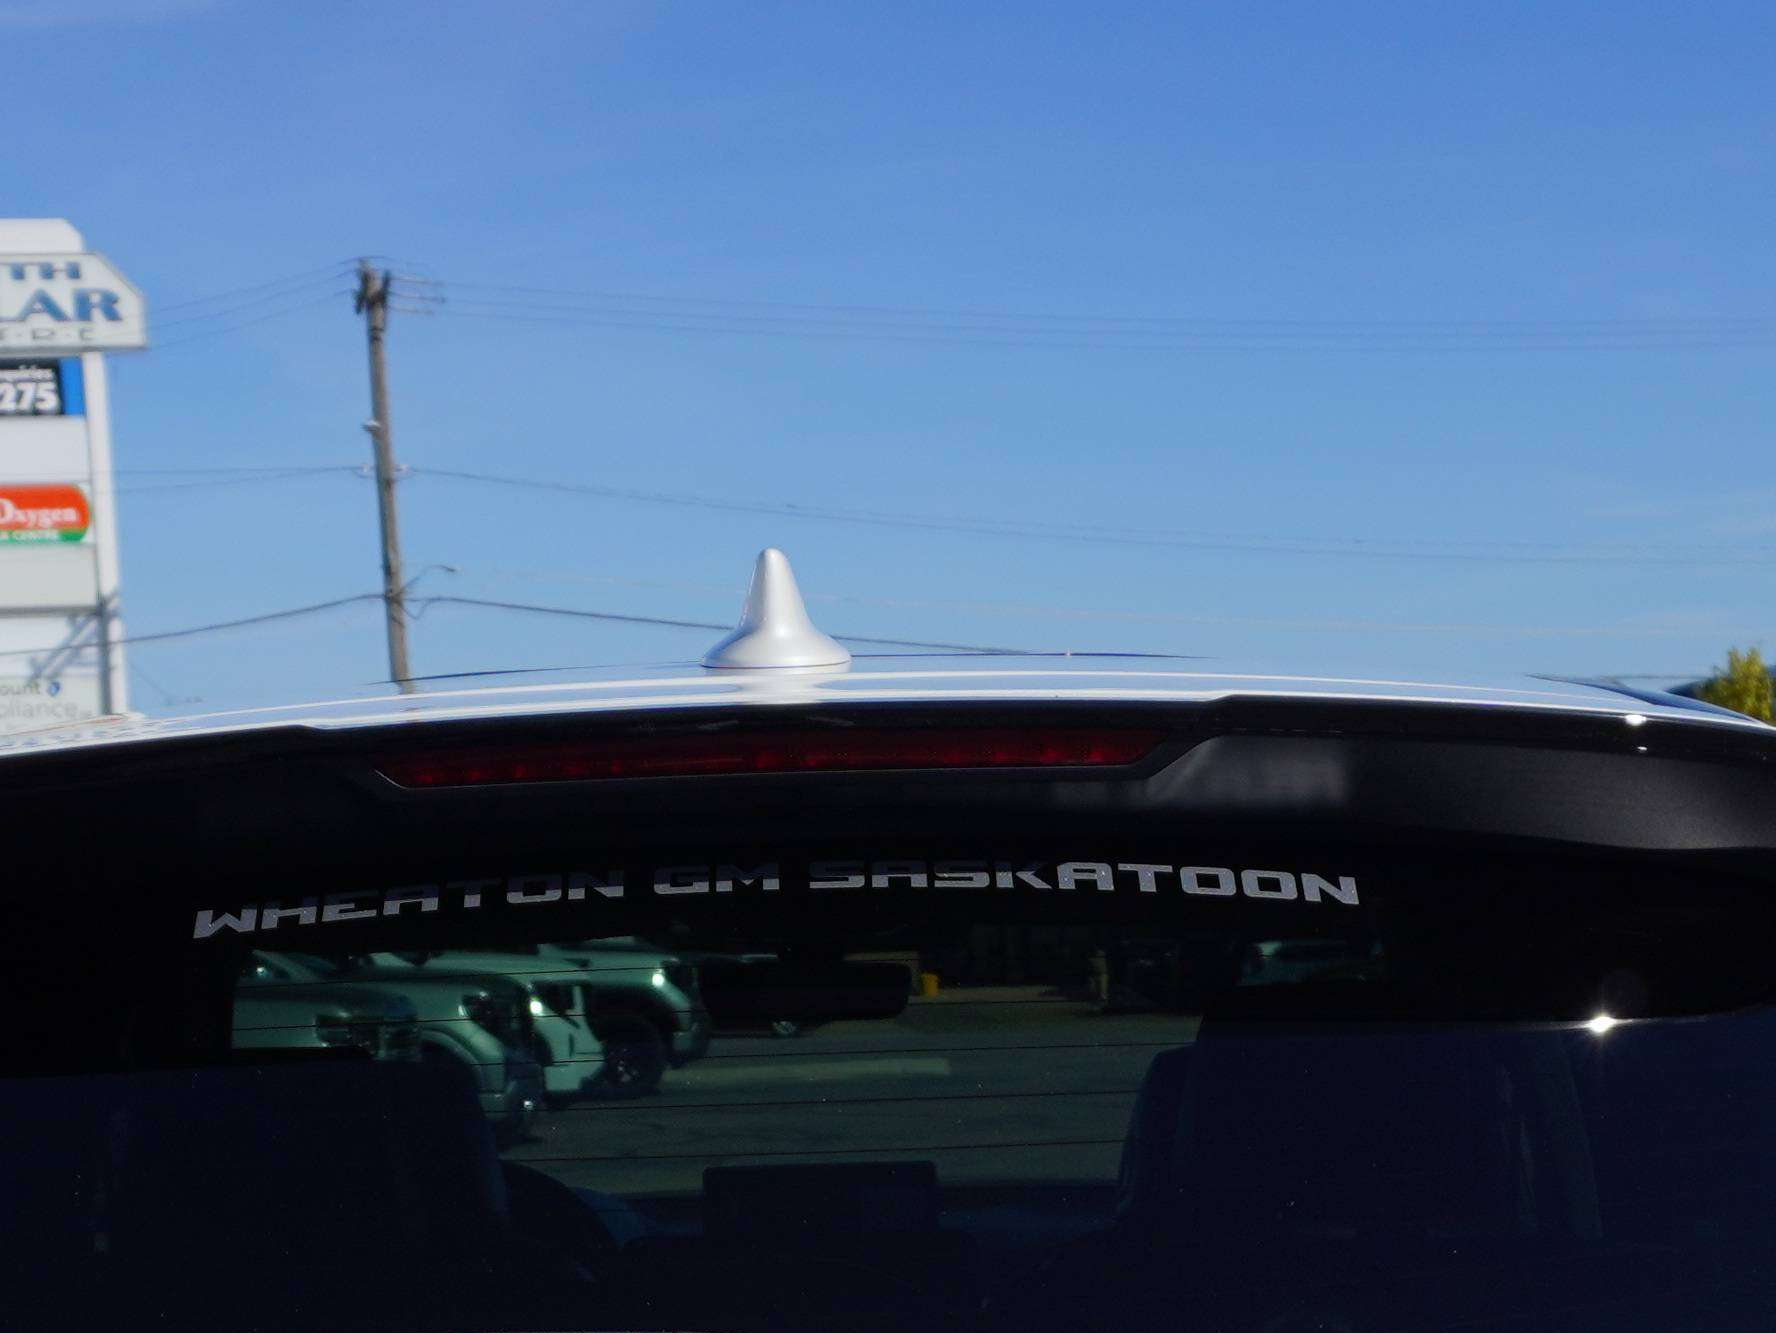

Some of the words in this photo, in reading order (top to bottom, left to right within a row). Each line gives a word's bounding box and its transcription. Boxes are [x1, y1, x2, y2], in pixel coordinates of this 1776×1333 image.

[193, 868, 625, 939] WHEATON
[653, 863, 780, 895] GM
[808, 859, 1361, 905] SASKATOON
